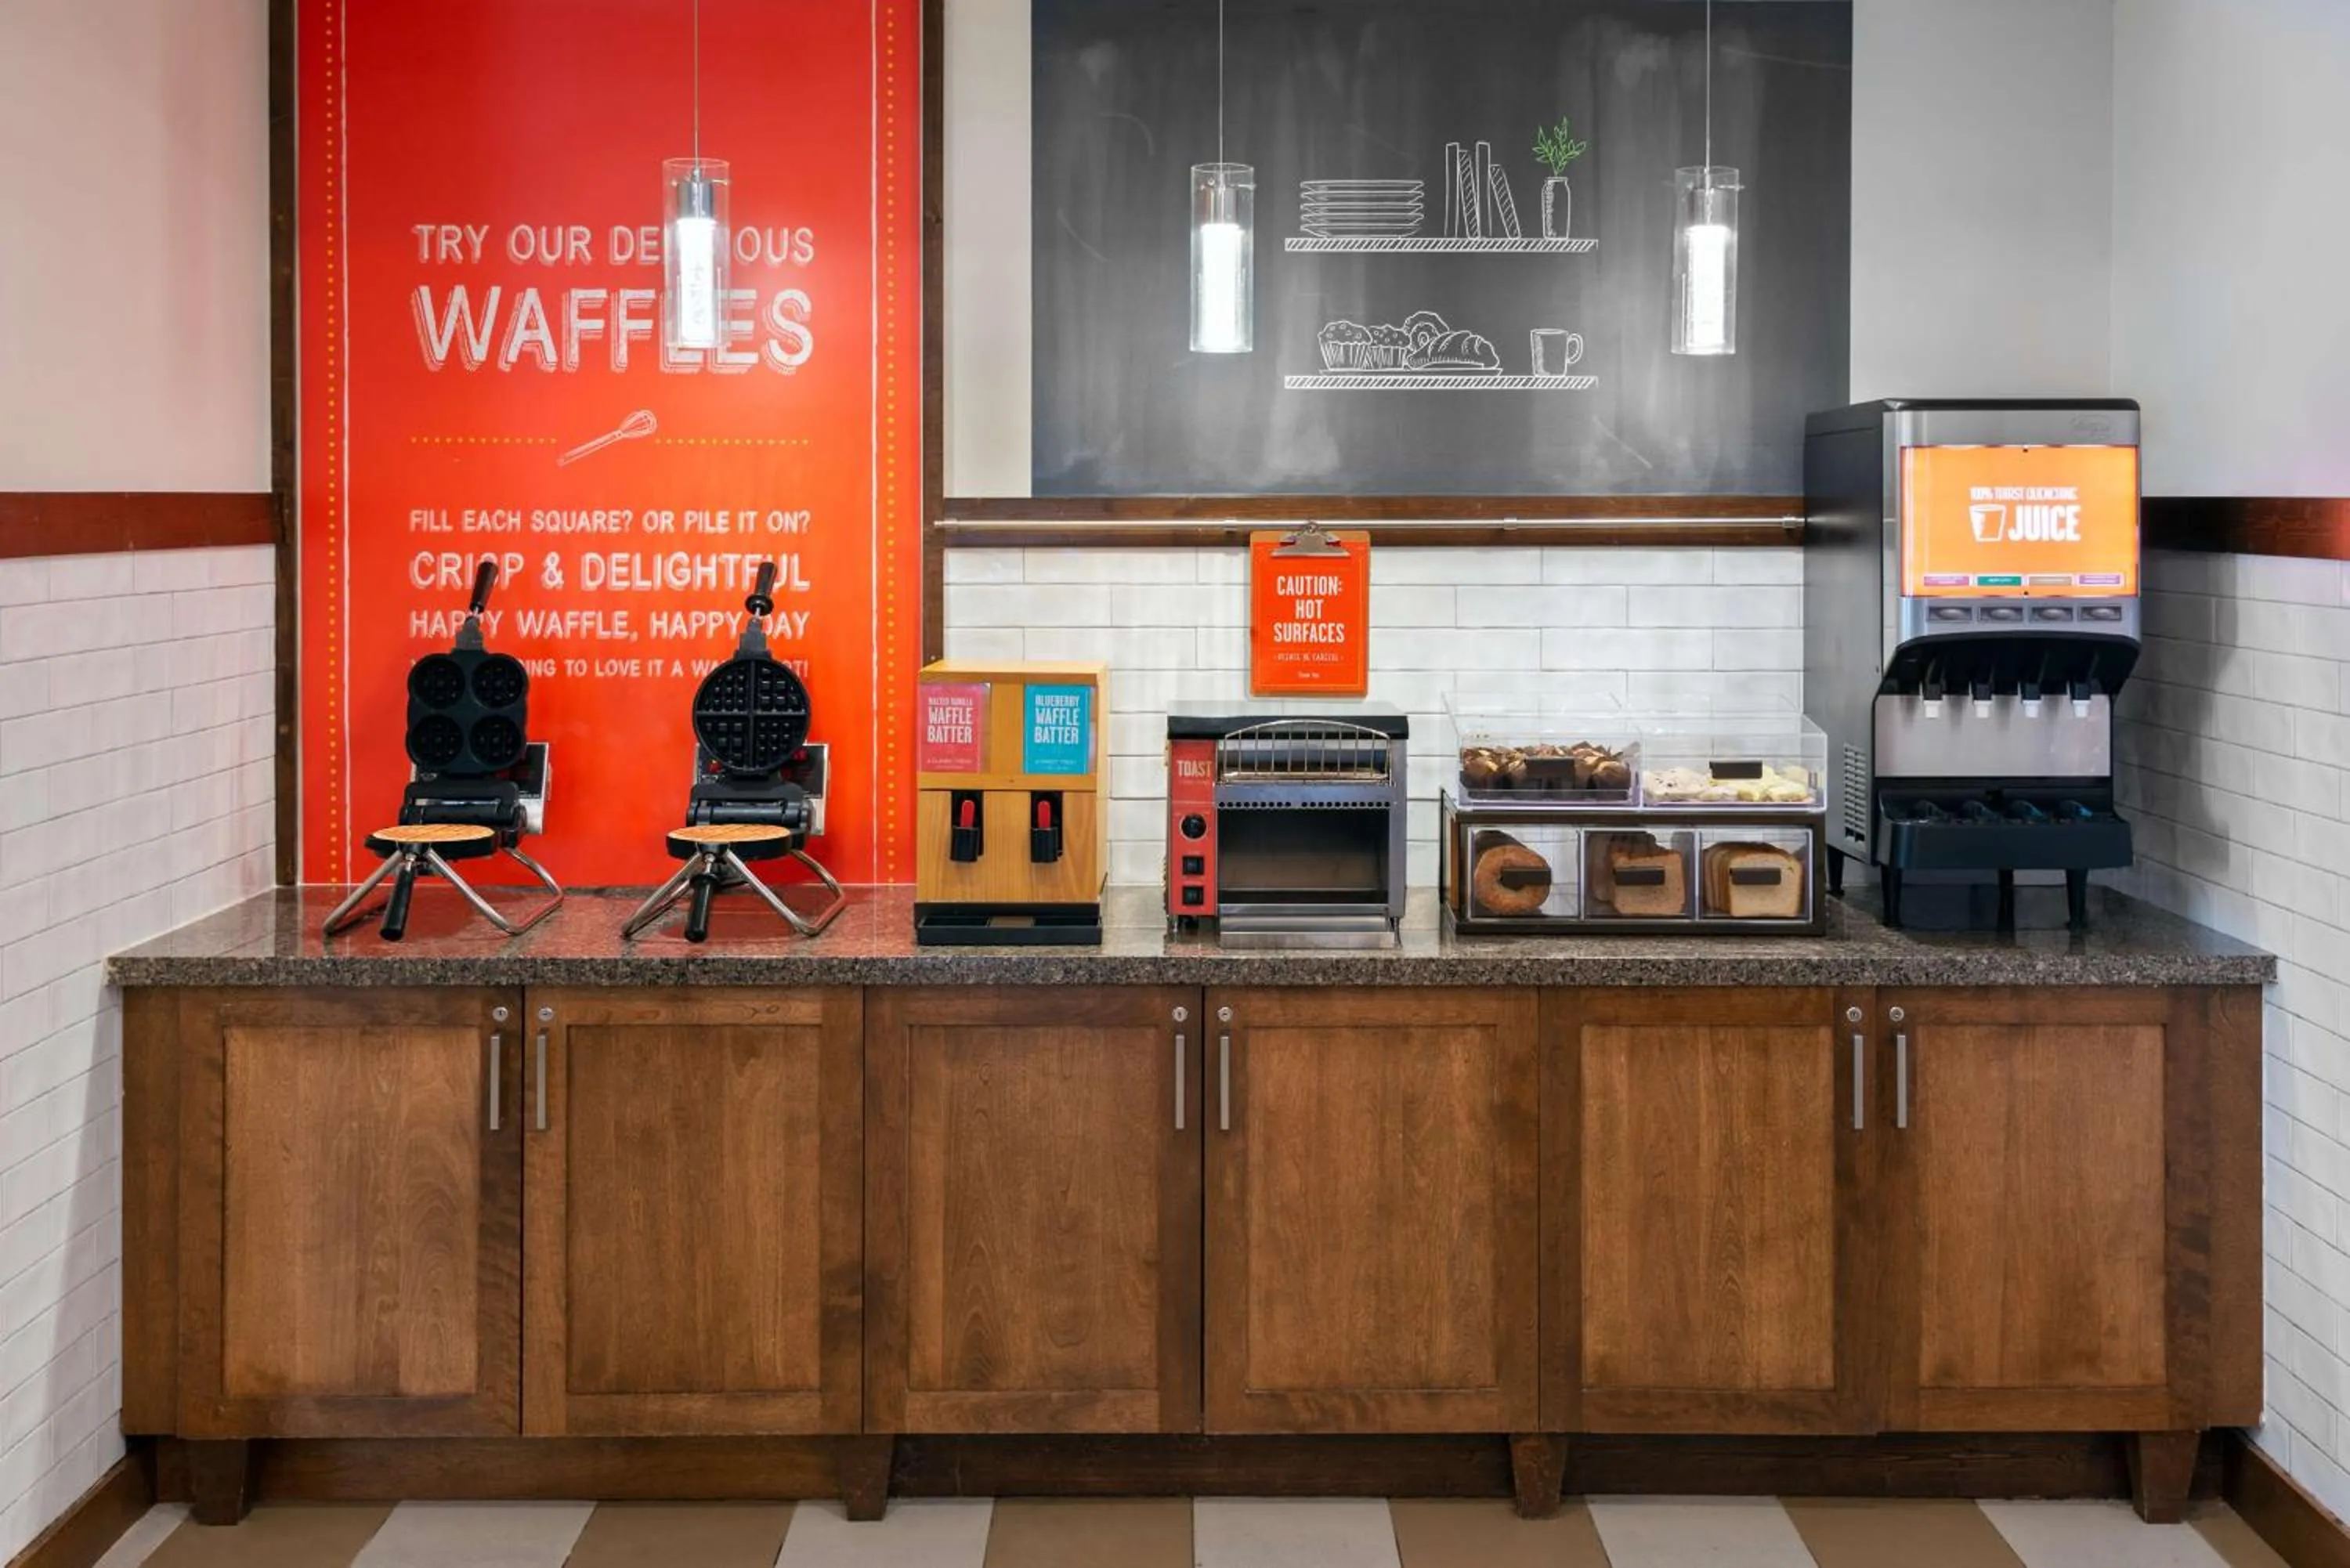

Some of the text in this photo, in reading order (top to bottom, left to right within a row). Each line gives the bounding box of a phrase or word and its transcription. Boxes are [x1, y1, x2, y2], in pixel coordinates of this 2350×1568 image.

[412, 224, 815, 266] TRY OUR DEOUS
[410, 510, 811, 533] FILL EACH SQUARE? OR PILE IT ON?
[2008, 504, 2081, 541] JUICE
[541, 551, 564, 590] &
[581, 551, 811, 592] DELIGHTFUL
[1277, 576, 1343, 596] CAUTION:
[1295, 599, 1324, 620] HOT
[410, 610, 503, 639] HAPY
[517, 610, 638, 642] WAFFLE,
[649, 610, 743, 640] HAPPY
[1273, 622, 1345, 643] SURFACES
[563, 659, 588, 677] TO
[595, 659, 640, 677] LOVE
[648, 659, 663, 677] IT
[671, 660, 684, 677] A
[1035, 695, 1079, 706] BLUEBERRY
[928, 707, 973, 724] WAFFLE
[1035, 707, 1079, 726] WAFFLE
[927, 725, 972, 743] BATTER
[1034, 727, 1079, 744] BATTER
[1177, 760, 1212, 777] TOAST
